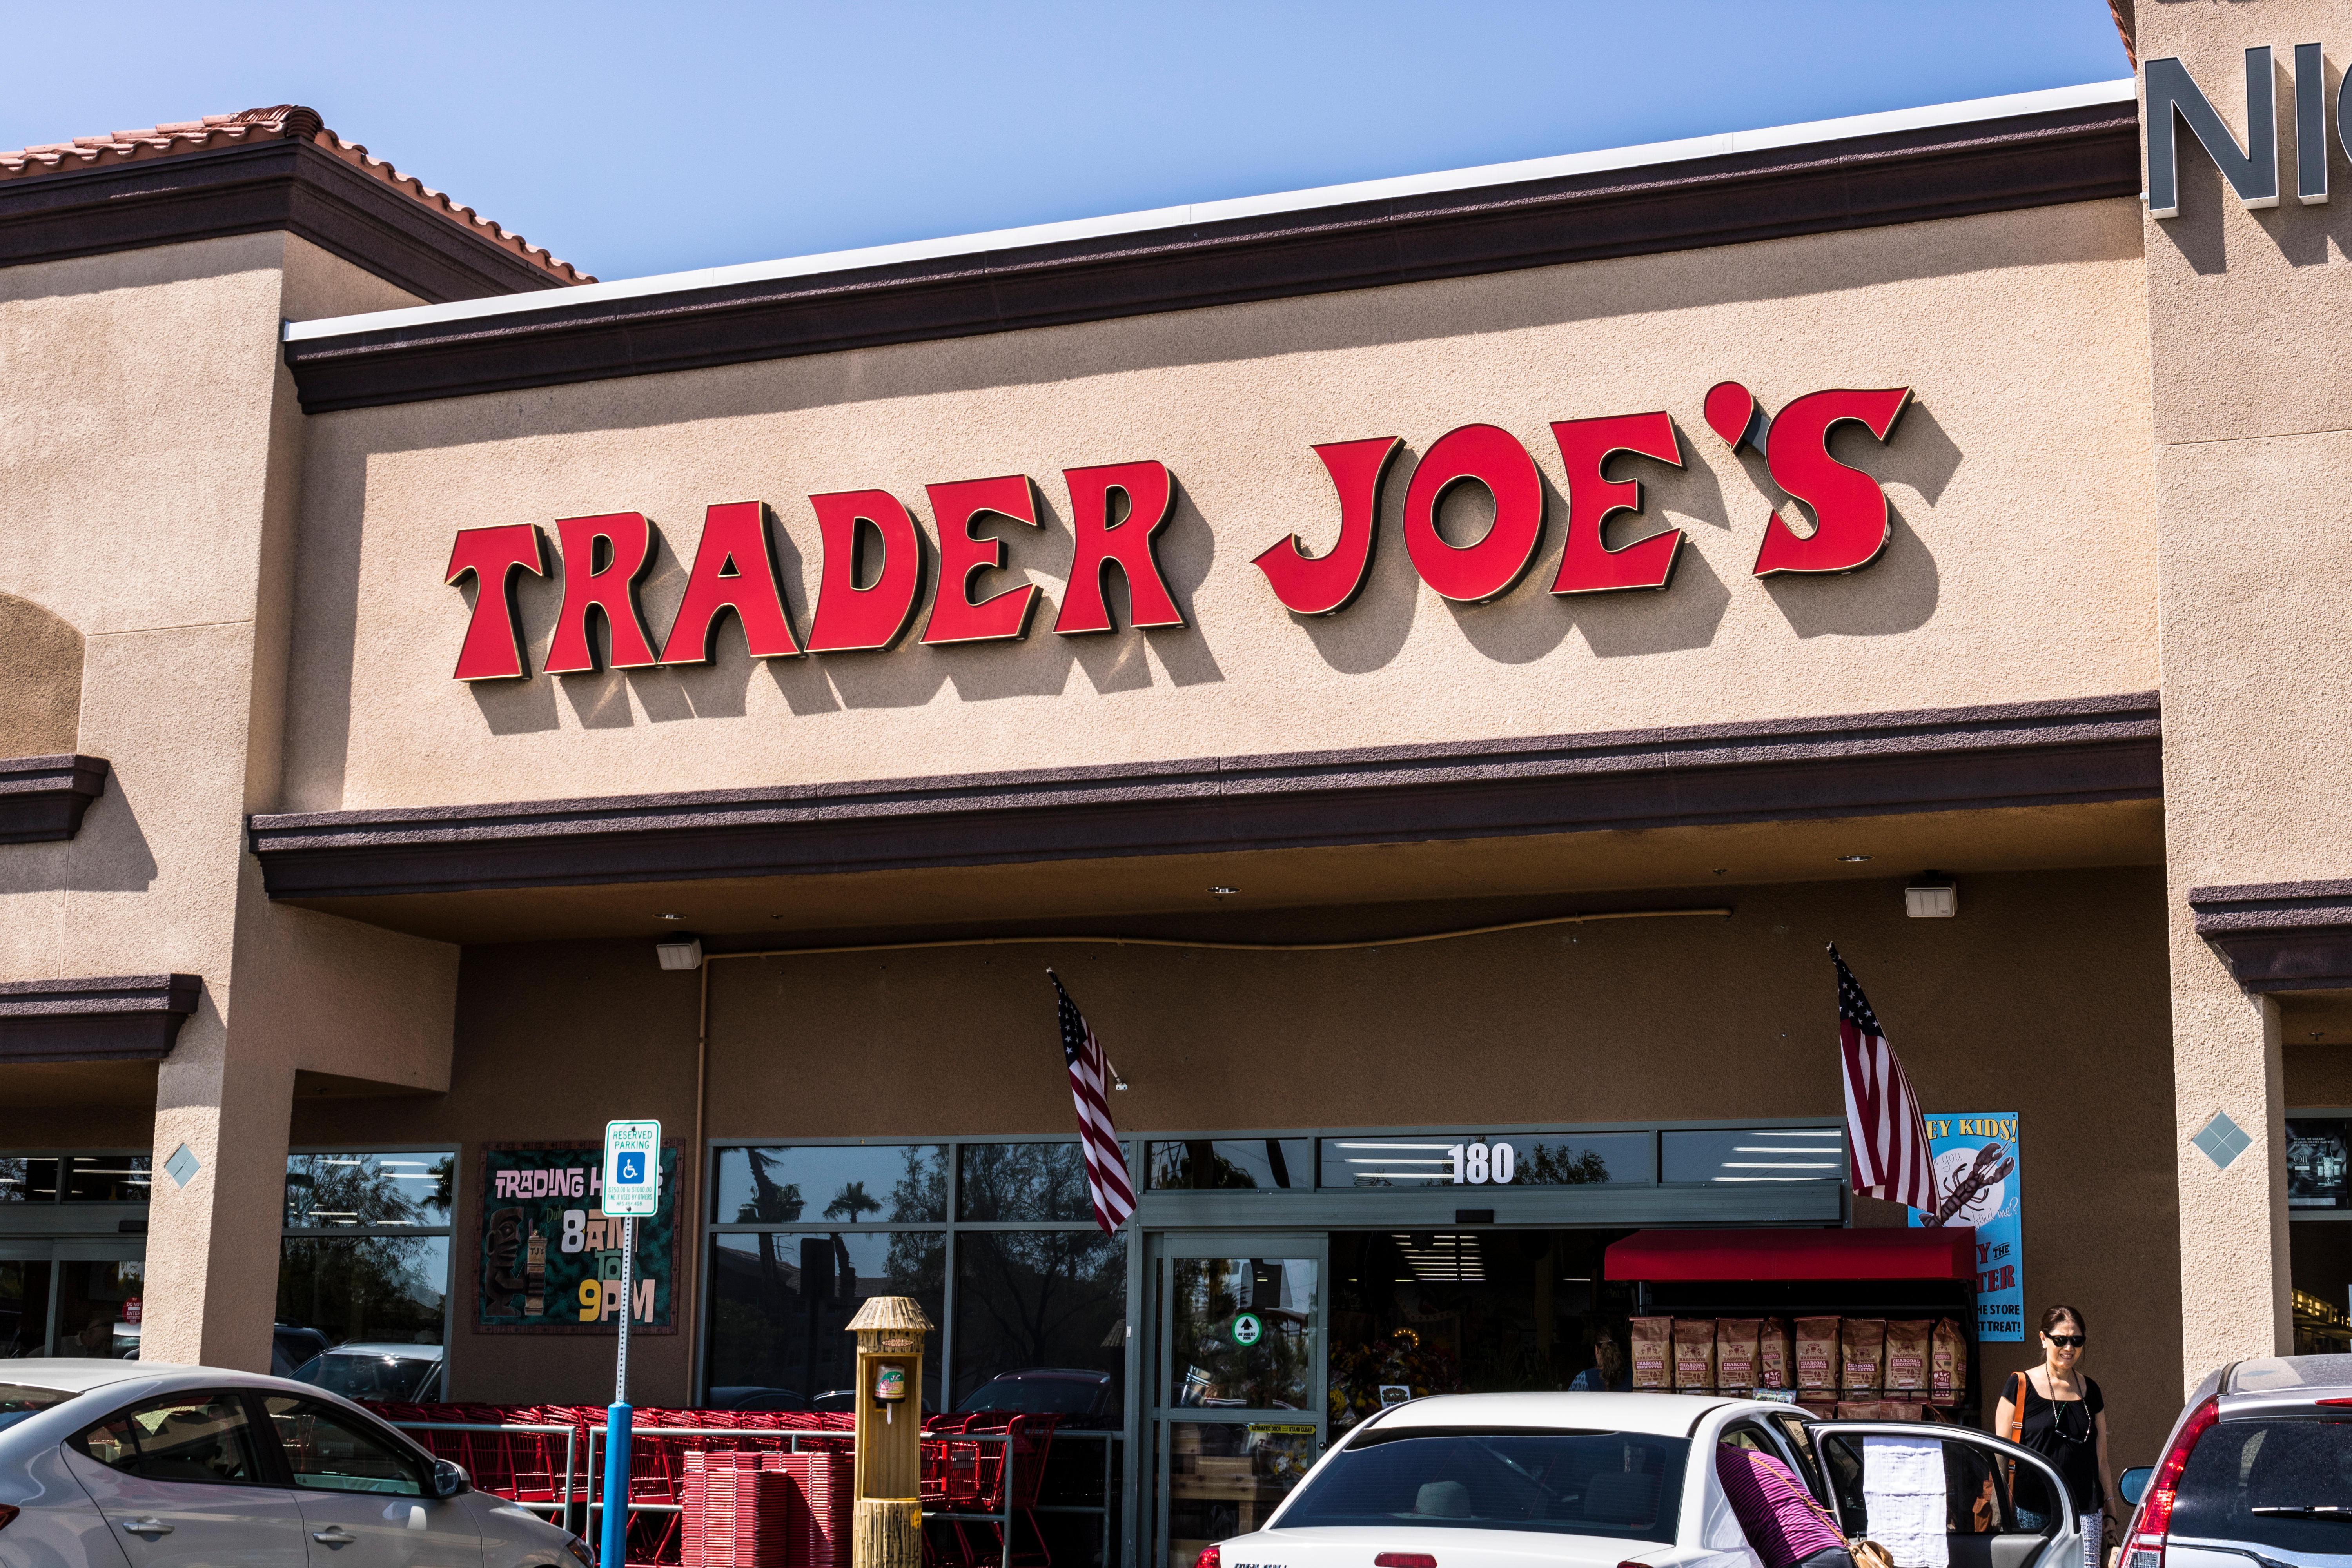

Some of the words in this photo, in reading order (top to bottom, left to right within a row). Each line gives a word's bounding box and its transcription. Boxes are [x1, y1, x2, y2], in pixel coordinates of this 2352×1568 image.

[2144, 42, 2352, 219] NI
[445, 461, 1190, 683] TRADER
[1249, 380, 1916, 617] JOE'S
[613, 1131, 652, 1140] RESERVED
[1926, 1120, 1952, 1140] EY
[1958, 1118, 2018, 1143] KIDS!
[614, 1140, 649, 1149] PARKING
[1447, 1142, 1514, 1184] 180
[495, 1168, 584, 1198] TRADING
[1998, 1197, 2018, 1219] me?
[1993, 1244, 2010, 1258] THE
[1978, 1304, 1988, 1315] HE
[1989, 1304, 2020, 1315] STORE
[1987, 1321, 2021, 1332] TREAT!
